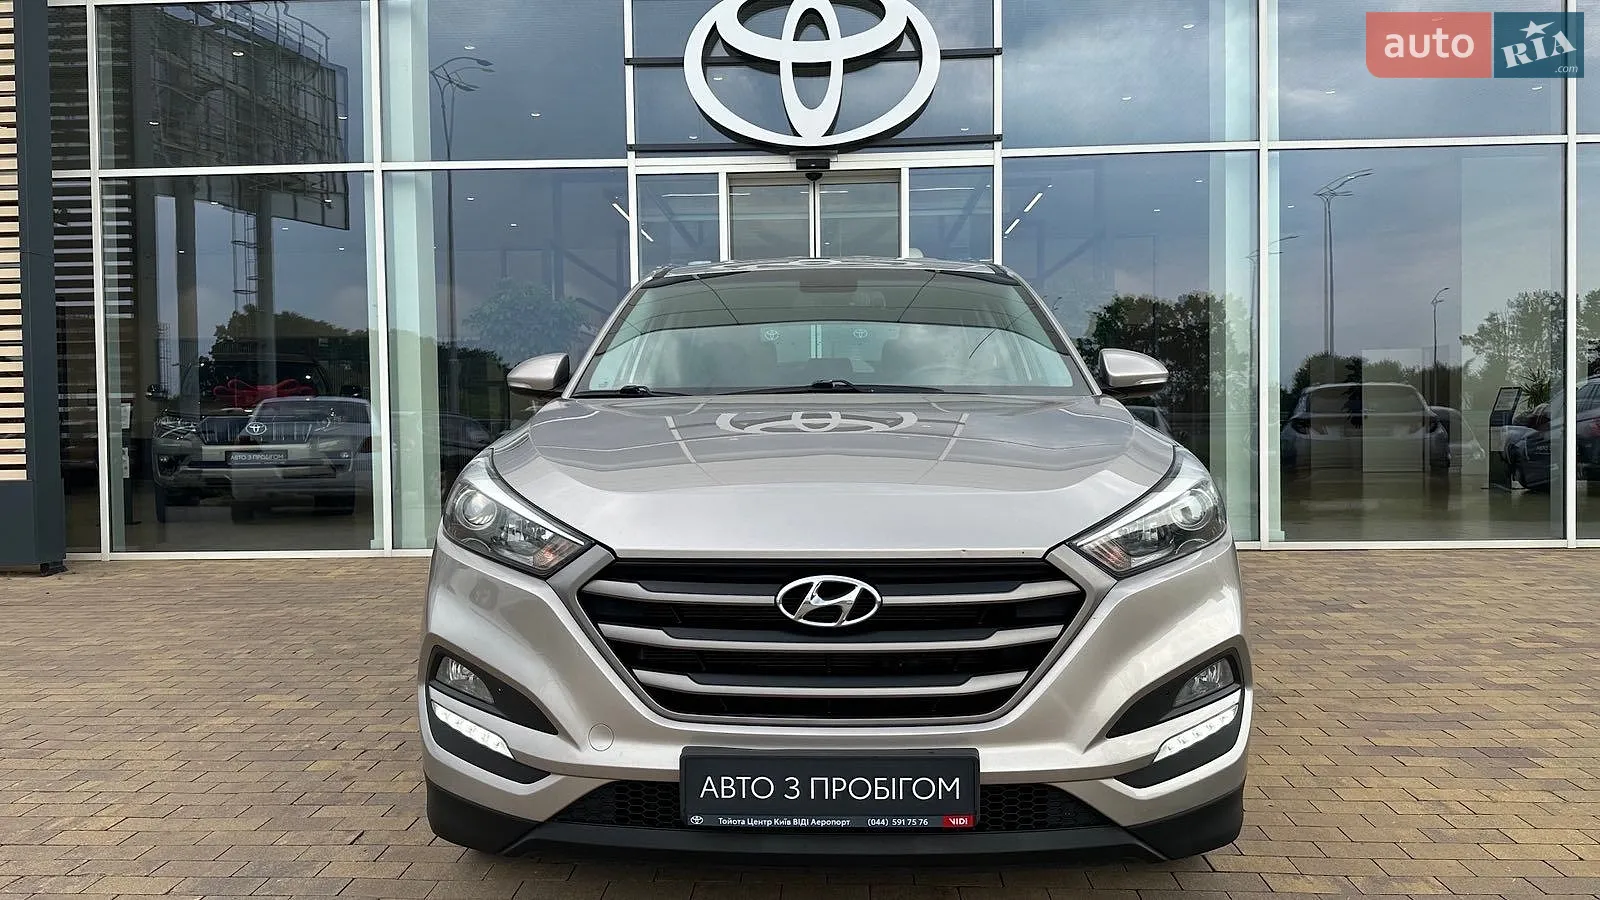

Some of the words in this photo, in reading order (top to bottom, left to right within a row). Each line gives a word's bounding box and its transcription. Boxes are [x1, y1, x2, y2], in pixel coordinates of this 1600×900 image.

[700, 776, 774, 800] АВТО
[784, 776, 800, 800] З
[810, 777, 960, 800] ПРОБІГОМ
[718, 817, 745, 826] Тойота
[747, 818, 772, 828] Центр
[773, 818, 791, 826] Київ
[792, 818, 809, 828] ВІДІ
[810, 819, 851, 828] Аеропорт
[867, 818, 889, 827] (044)
[892, 819, 906, 827] 591
[907, 819, 917, 827] 75
[919, 819, 929, 827] 76
[949, 817, 968, 826] VIDI
